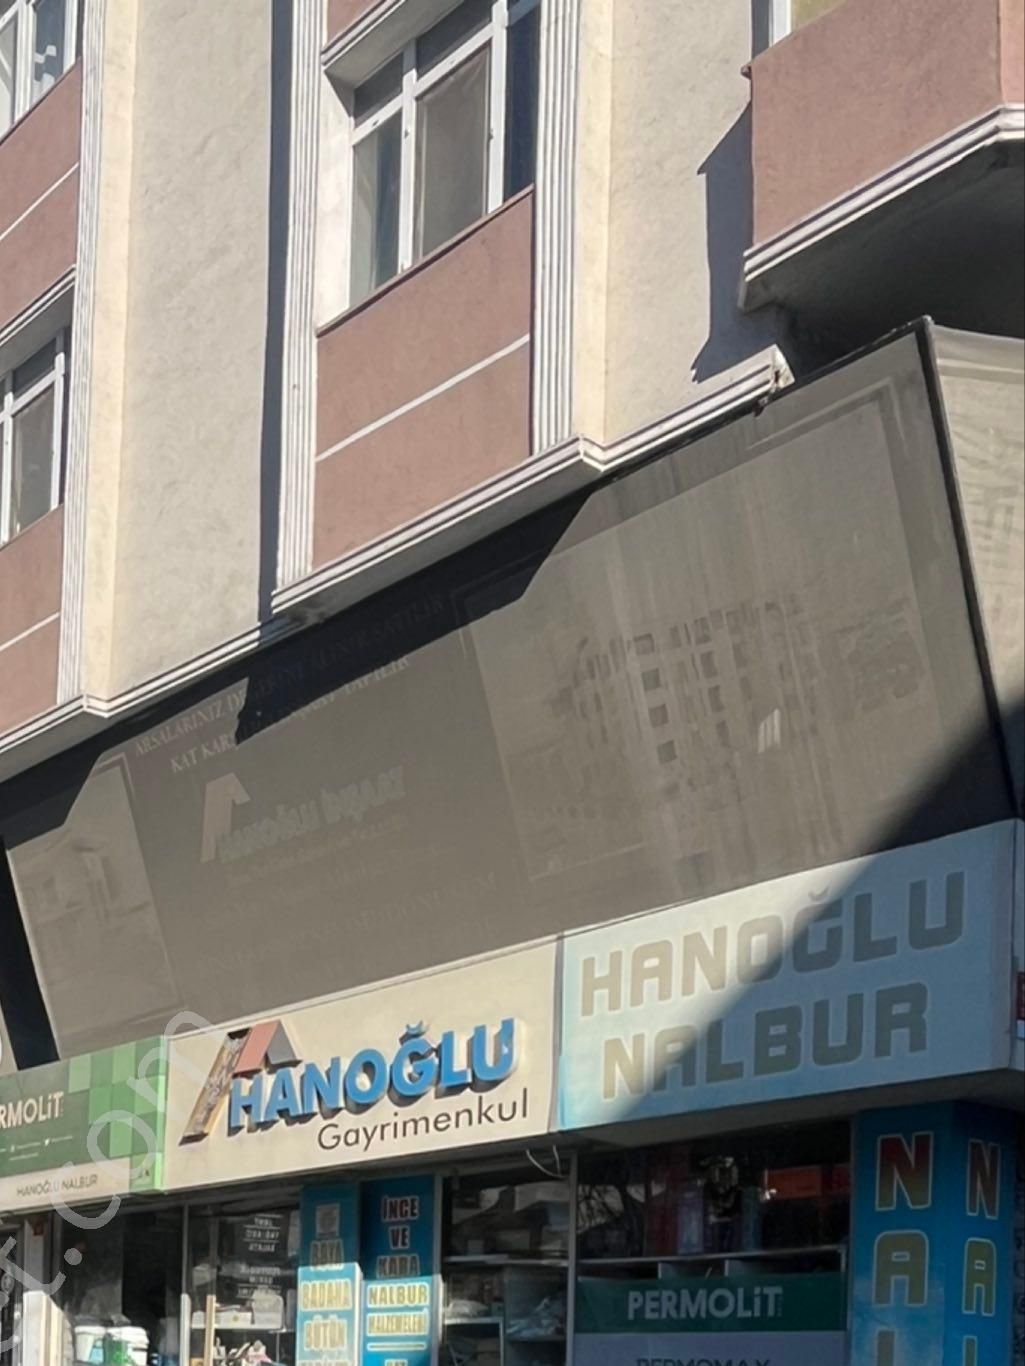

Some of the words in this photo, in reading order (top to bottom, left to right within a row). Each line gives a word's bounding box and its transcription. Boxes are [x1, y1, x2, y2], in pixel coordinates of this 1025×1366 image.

[580, 870, 965, 1017] HANOĞLU
[602, 981, 928, 1100] NALBUR
[228, 1018, 517, 1135] HANOĞLU
[317, 1087, 528, 1152] Gayrimenkul
[382, 1195, 419, 1222] İNCE
[390, 1226, 409, 1249] VE
[367, 1283, 429, 1307] NALBUR
